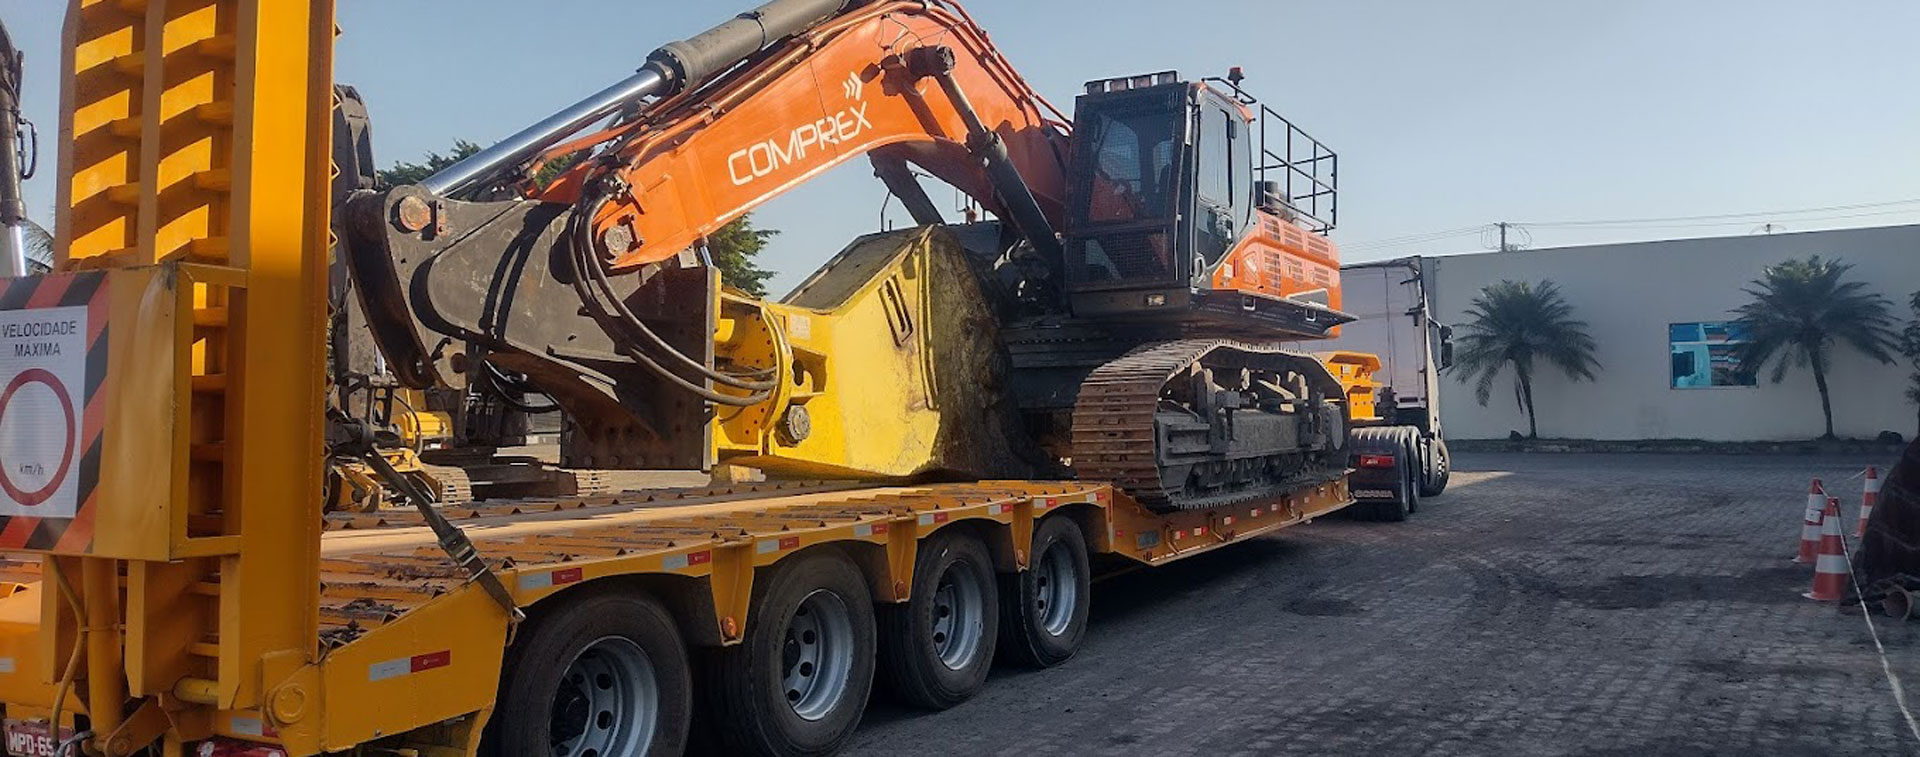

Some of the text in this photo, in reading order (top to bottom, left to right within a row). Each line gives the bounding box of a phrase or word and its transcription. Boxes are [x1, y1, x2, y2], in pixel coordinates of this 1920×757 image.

[727, 101, 872, 186] COMPREX
[2, 321, 77, 338] VELOCIDADE
[20, 463, 44, 476] km/h
